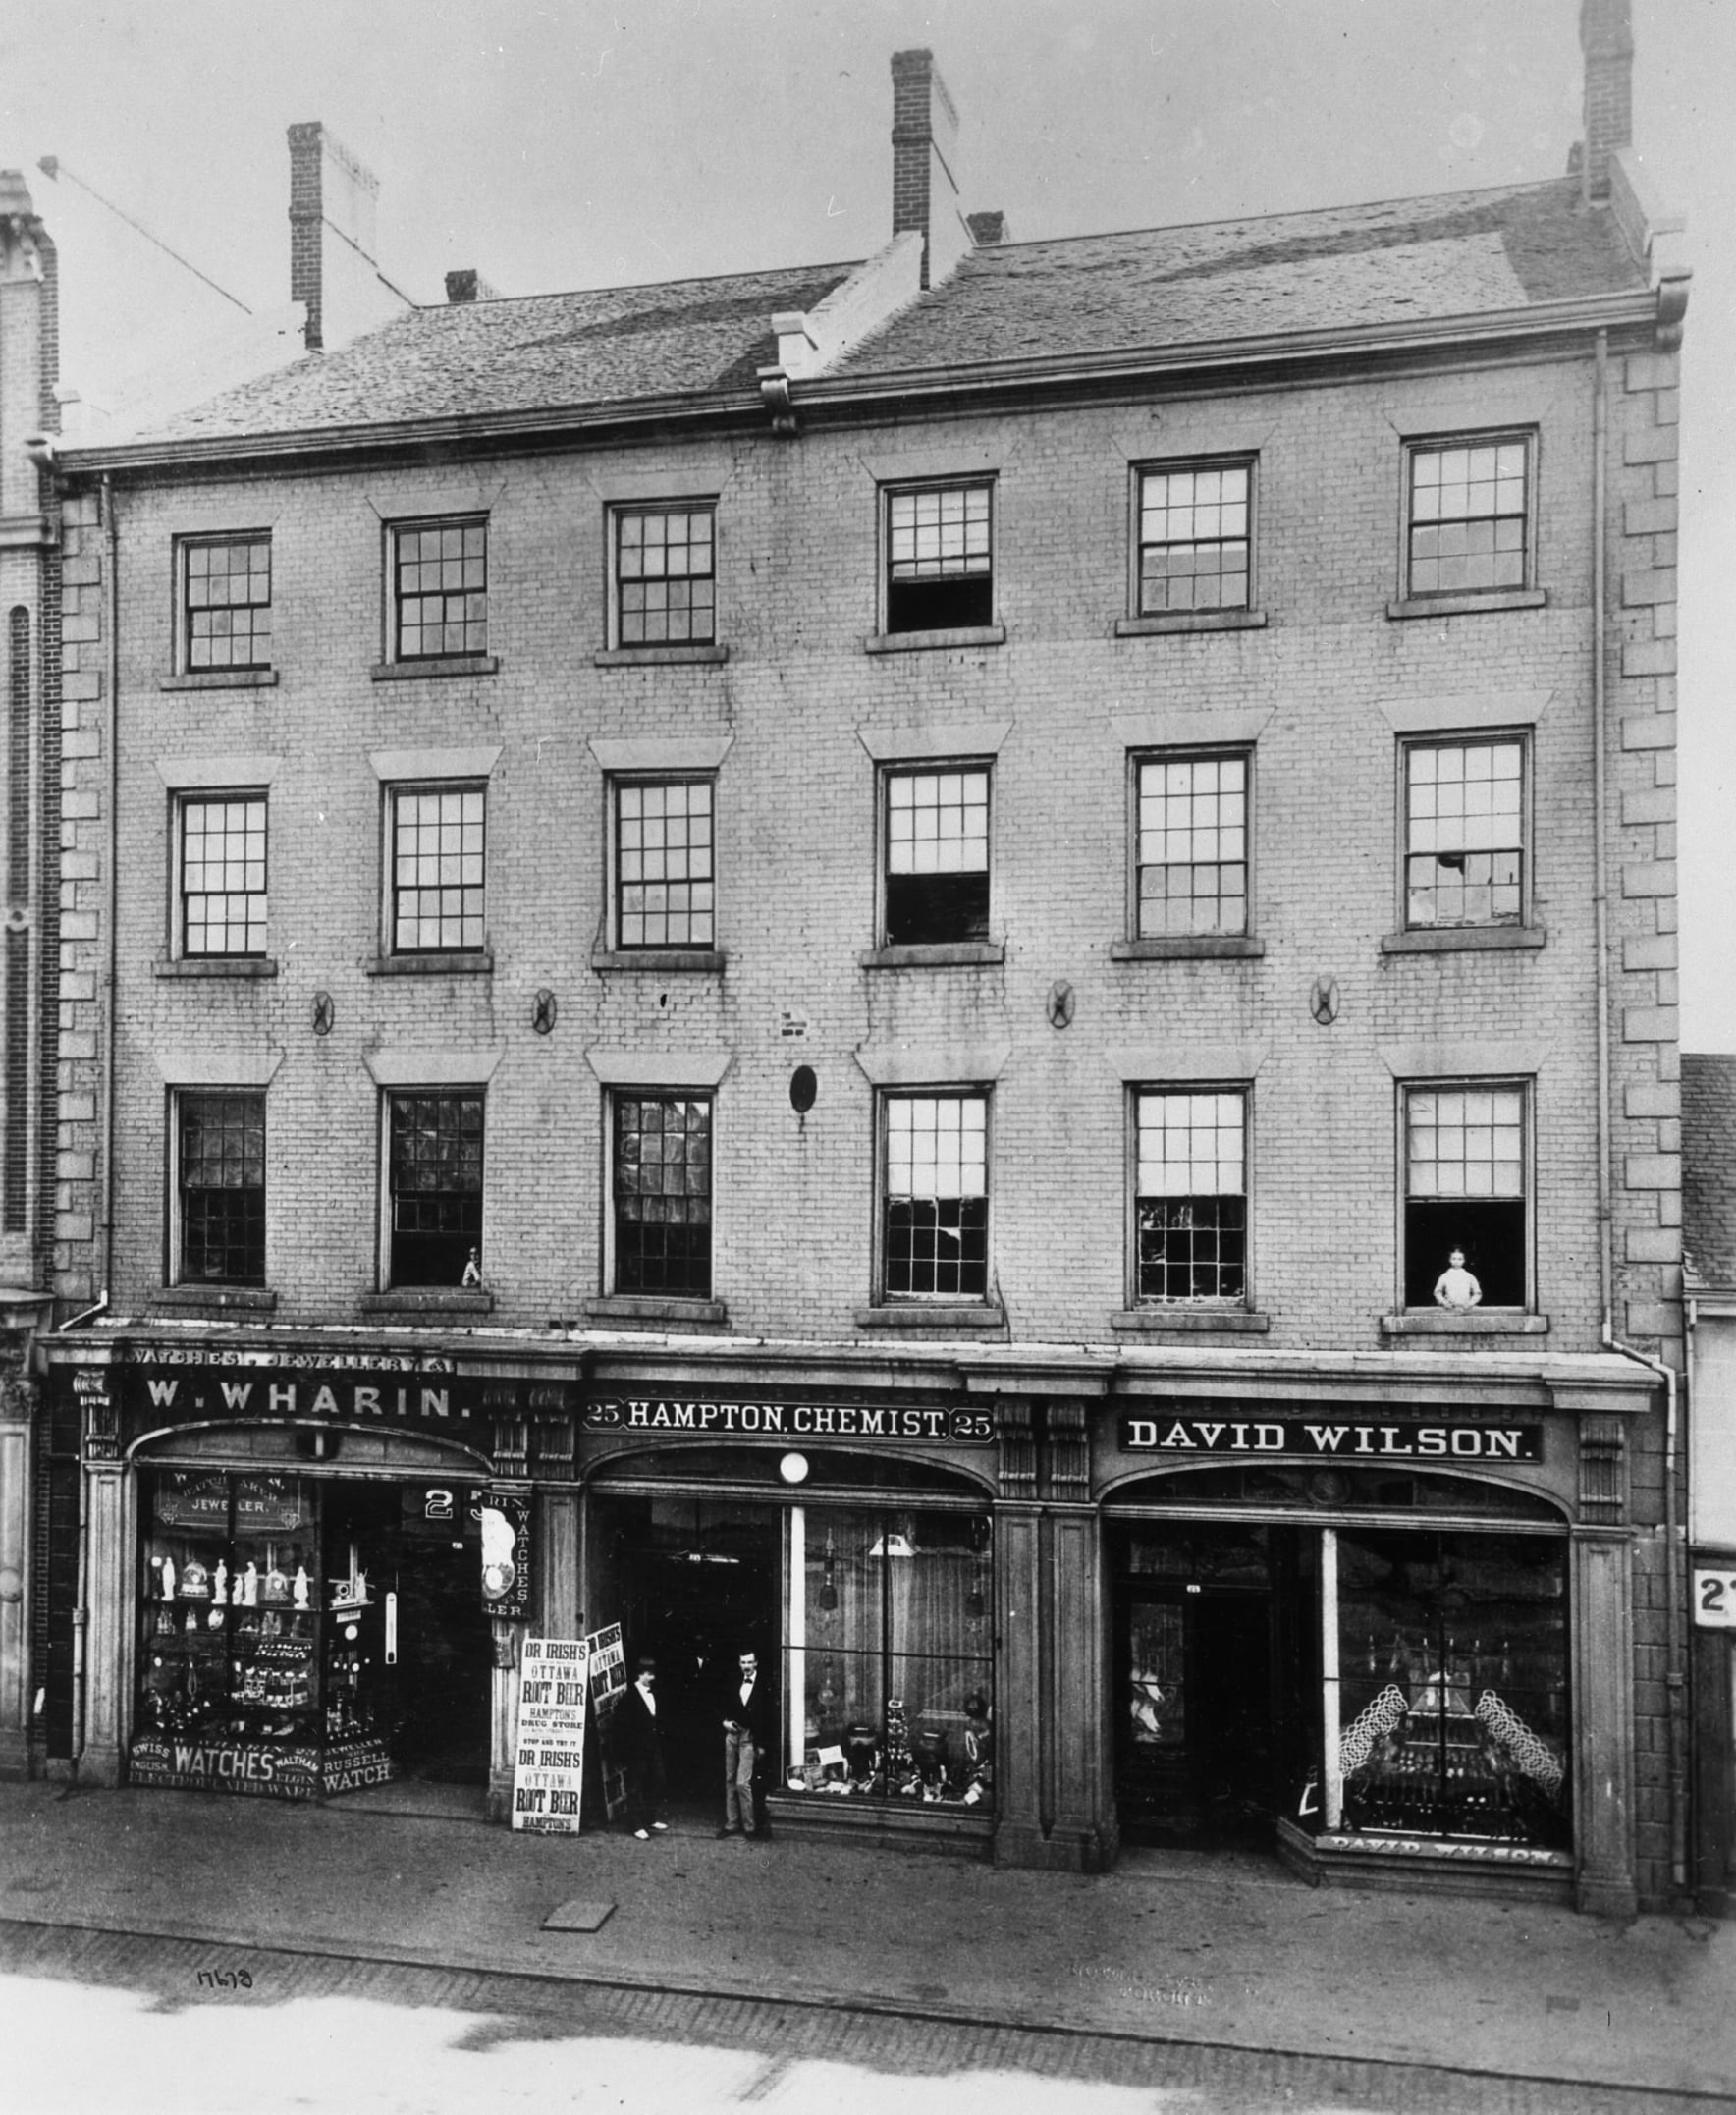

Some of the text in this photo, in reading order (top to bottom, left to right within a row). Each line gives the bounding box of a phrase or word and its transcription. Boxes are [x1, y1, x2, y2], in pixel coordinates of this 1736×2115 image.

[266, 1352, 421, 1373] JEWELLERY
[147, 1379, 471, 1419] W. WHARIN.
[588, 1403, 622, 1426] 25
[954, 1414, 992, 1438] 25
[1126, 1419, 1534, 1458] DAVID WILSON.
[1700, 1577, 1736, 1613] 2
[525, 1643, 542, 1659] DR
[531, 1665, 578, 1680] OTTAWA
[521, 1680, 553, 1705] ROOT
[556, 1681, 585, 1707] BEER
[521, 1719, 583, 1730] DRUG STORE
[132, 1742, 171, 1759] SWISS
[518, 1748, 536, 1766] DR
[174, 1745, 275, 1782] WATCHES
[274, 1755, 320, 1773] WALTHAM
[324, 1751, 391, 1774] RUSSELL
[322, 1762, 393, 1794] WATCH
[524, 1772, 572, 1789] OTTAWA
[515, 1788, 579, 1815] ROOT BEER
